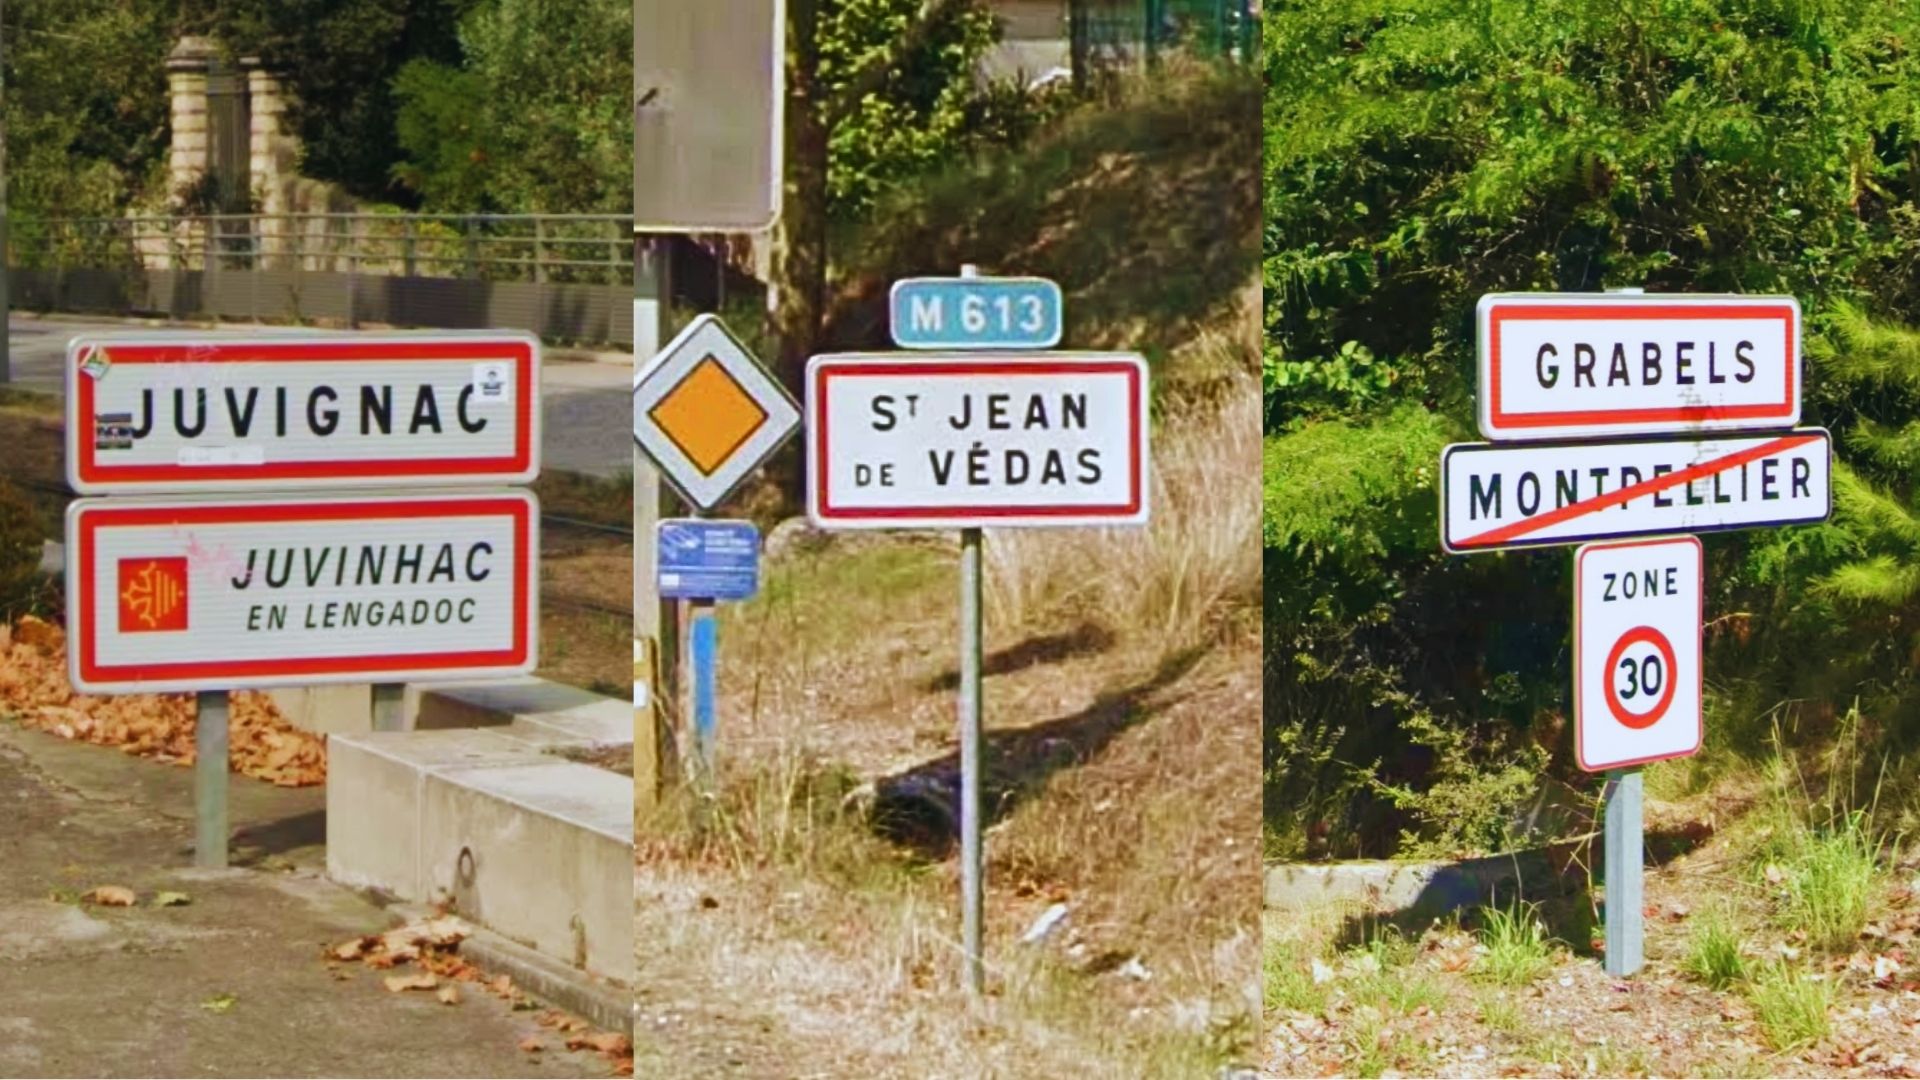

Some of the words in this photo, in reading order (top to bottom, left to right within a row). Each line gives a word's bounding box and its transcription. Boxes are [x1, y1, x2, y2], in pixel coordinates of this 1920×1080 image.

[910, 294, 943, 332] M
[960, 293, 1043, 333] 613
[1535, 340, 1756, 389] GRABELS
[131, 384, 489, 439] JUVIGNAC
[949, 393, 1087, 431] JEAN
[855, 462, 895, 488] DE
[928, 441, 1102, 487] VÉDAS
[1469, 456, 1811, 521] MONTPELLIER
[231, 541, 494, 590] JUVINHAC
[1602, 567, 1678, 602] ZONE
[246, 604, 288, 632] EN
[304, 597, 477, 629] LENGADOC
[1619, 654, 1662, 700] 30
